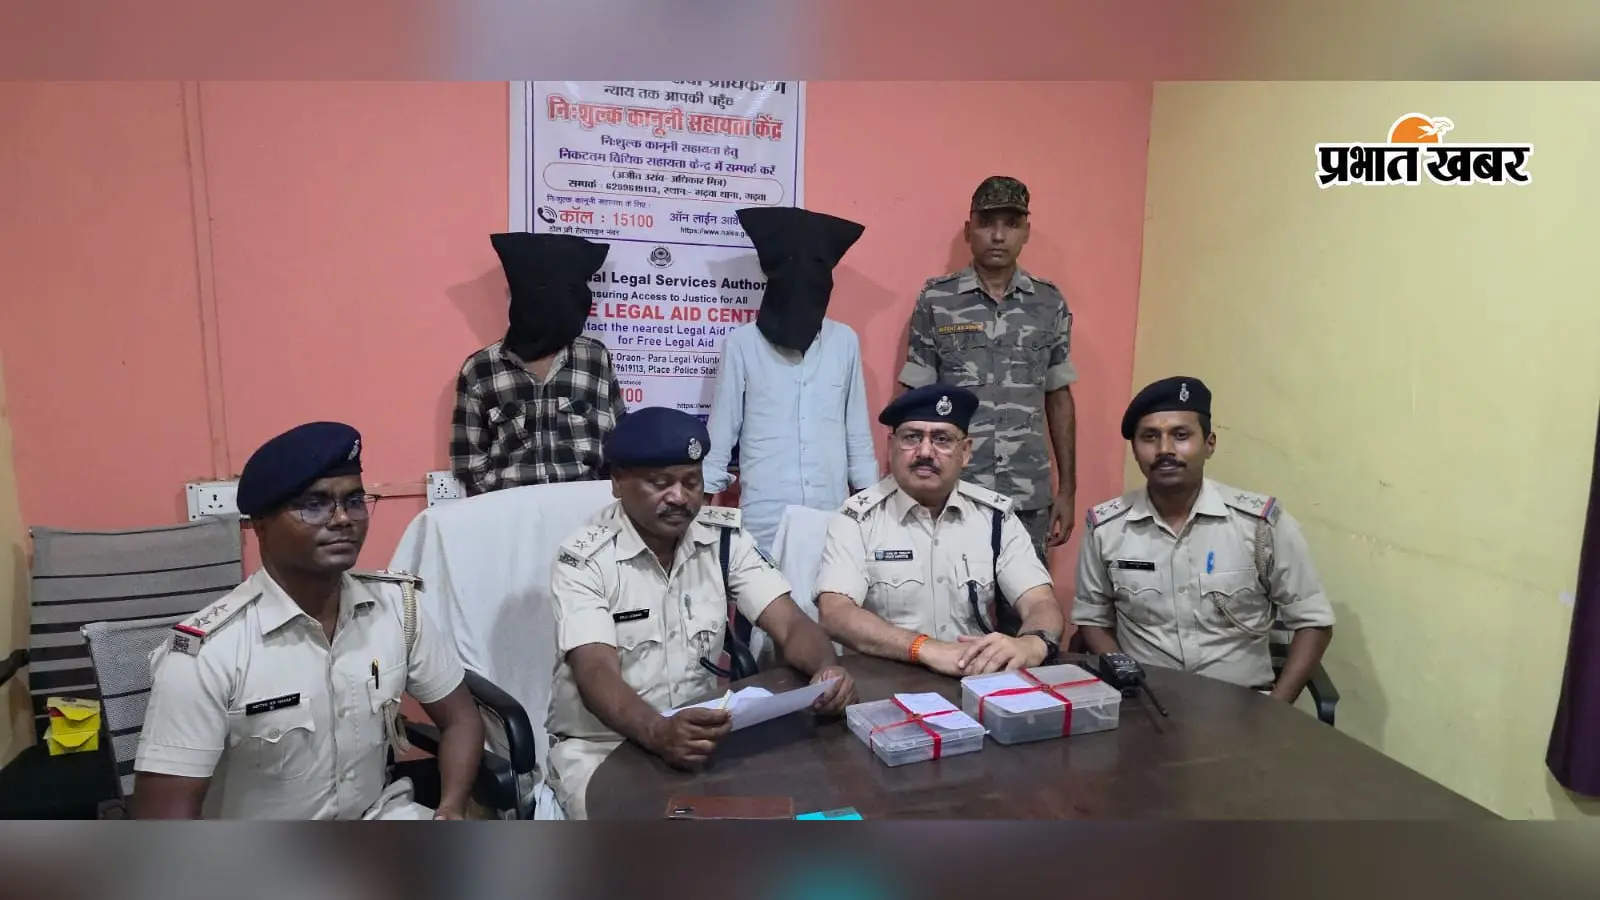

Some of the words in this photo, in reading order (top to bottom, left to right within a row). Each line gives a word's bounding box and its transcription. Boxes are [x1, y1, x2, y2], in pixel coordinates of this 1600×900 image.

[604, 85, 634, 98] न्याय
[637, 88, 660, 100] तक
[664, 91, 704, 104] आपकी
[626, 106, 684, 136] कानूनी
[686, 112, 752, 137] सहायता
[559, 147, 606, 161] निकटतम
[609, 152, 643, 165] विधिक
[646, 157, 686, 168] सहायता
[645, 141, 678, 153] कानूनी
[681, 143, 720, 155] सहायता
[724, 145, 739, 158] हेतु
[559, 206, 594, 224] कॉल
[614, 212, 654, 228] 15100
[670, 211, 689, 222] ऑन
[693, 212, 717, 225] लाईन
[721, 214, 740, 225] आवे
[611, 272, 651, 287] Legal
[656, 274, 717, 288] Services
[721, 278, 767, 290] Author
[592, 290, 628, 300] nsuring
[631, 291, 667, 301] Access
[682, 294, 717, 303] Justice
[720, 295, 733, 304] for
[605, 303, 664, 320] LEGAL
[670, 306, 701, 321] AID
[612, 323, 628, 331] the
[633, 325, 673, 333] nearest
[677, 325, 706, 336] Legal
[709, 326, 726, 335] Aid
[619, 335, 633, 344] for
[638, 336, 662, 346] Free
[666, 337, 694, 348] Legal
[697, 338, 714, 347] Aid
[648, 354, 666, 363] Para
[669, 355, 691, 365] Legal
[648, 365, 670, 373] Place
